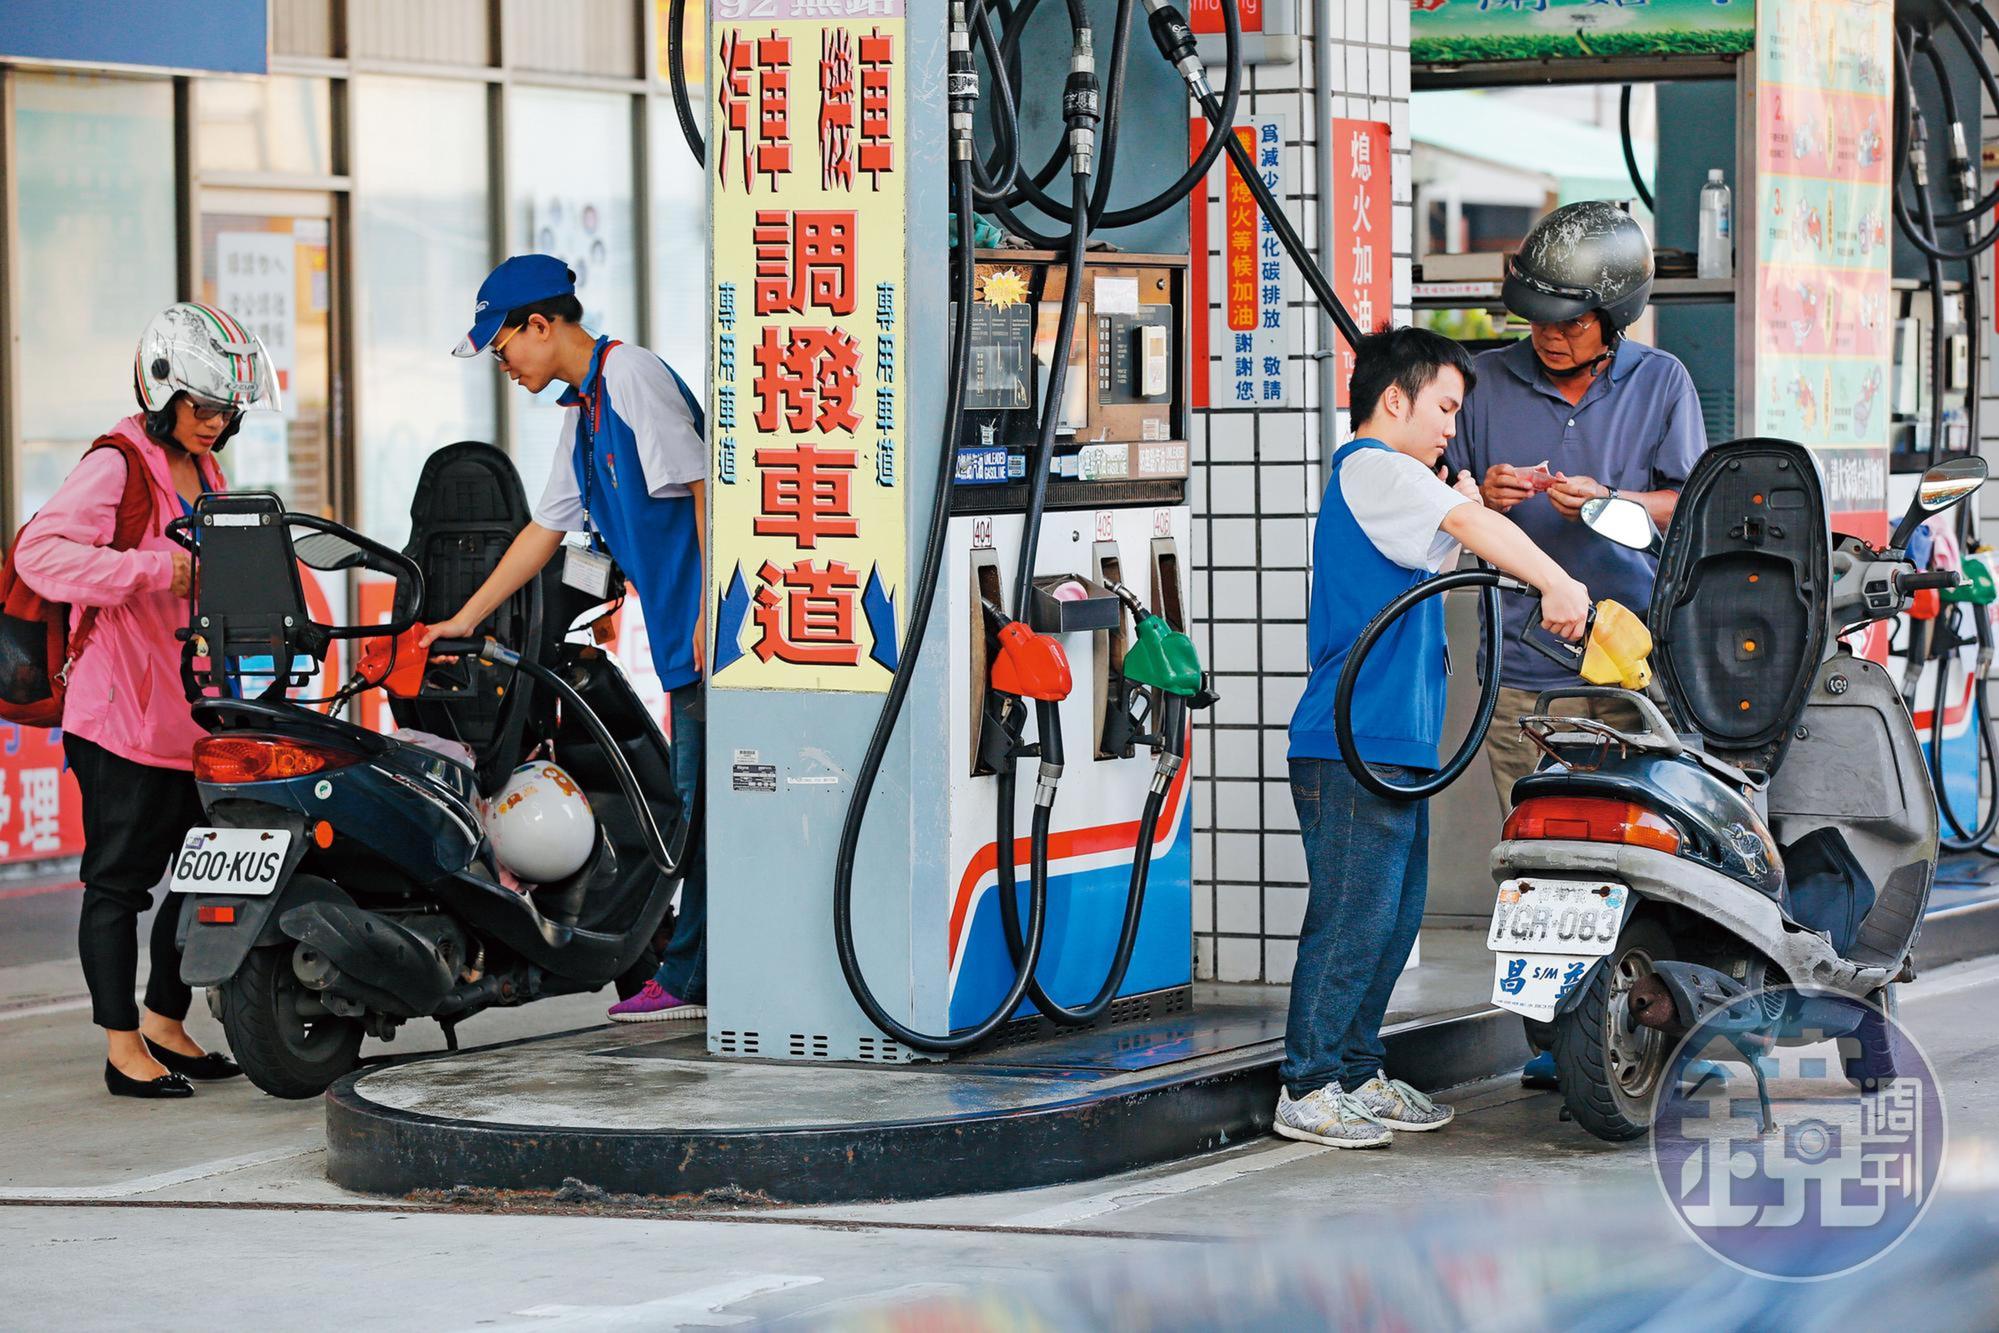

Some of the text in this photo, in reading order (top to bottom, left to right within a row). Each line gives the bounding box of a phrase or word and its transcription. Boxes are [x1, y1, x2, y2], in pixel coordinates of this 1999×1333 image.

[718, 26, 894, 195] 汽車 機車
[1231, 131, 1254, 400] 熄火等候加油 謝謝您
[1350, 131, 1373, 333] 熄火加油
[718, 282, 737, 486] 專用車道
[752, 210, 864, 667] 調撥車道
[876, 282, 895, 488] 專用車道
[975, 521, 991, 543] 404
[1098, 513, 1112, 538] 405
[177, 850, 280, 883] 600-KUS
[1499, 958, 1528, 996] 昌
[1532, 967, 1559, 980] S/M
